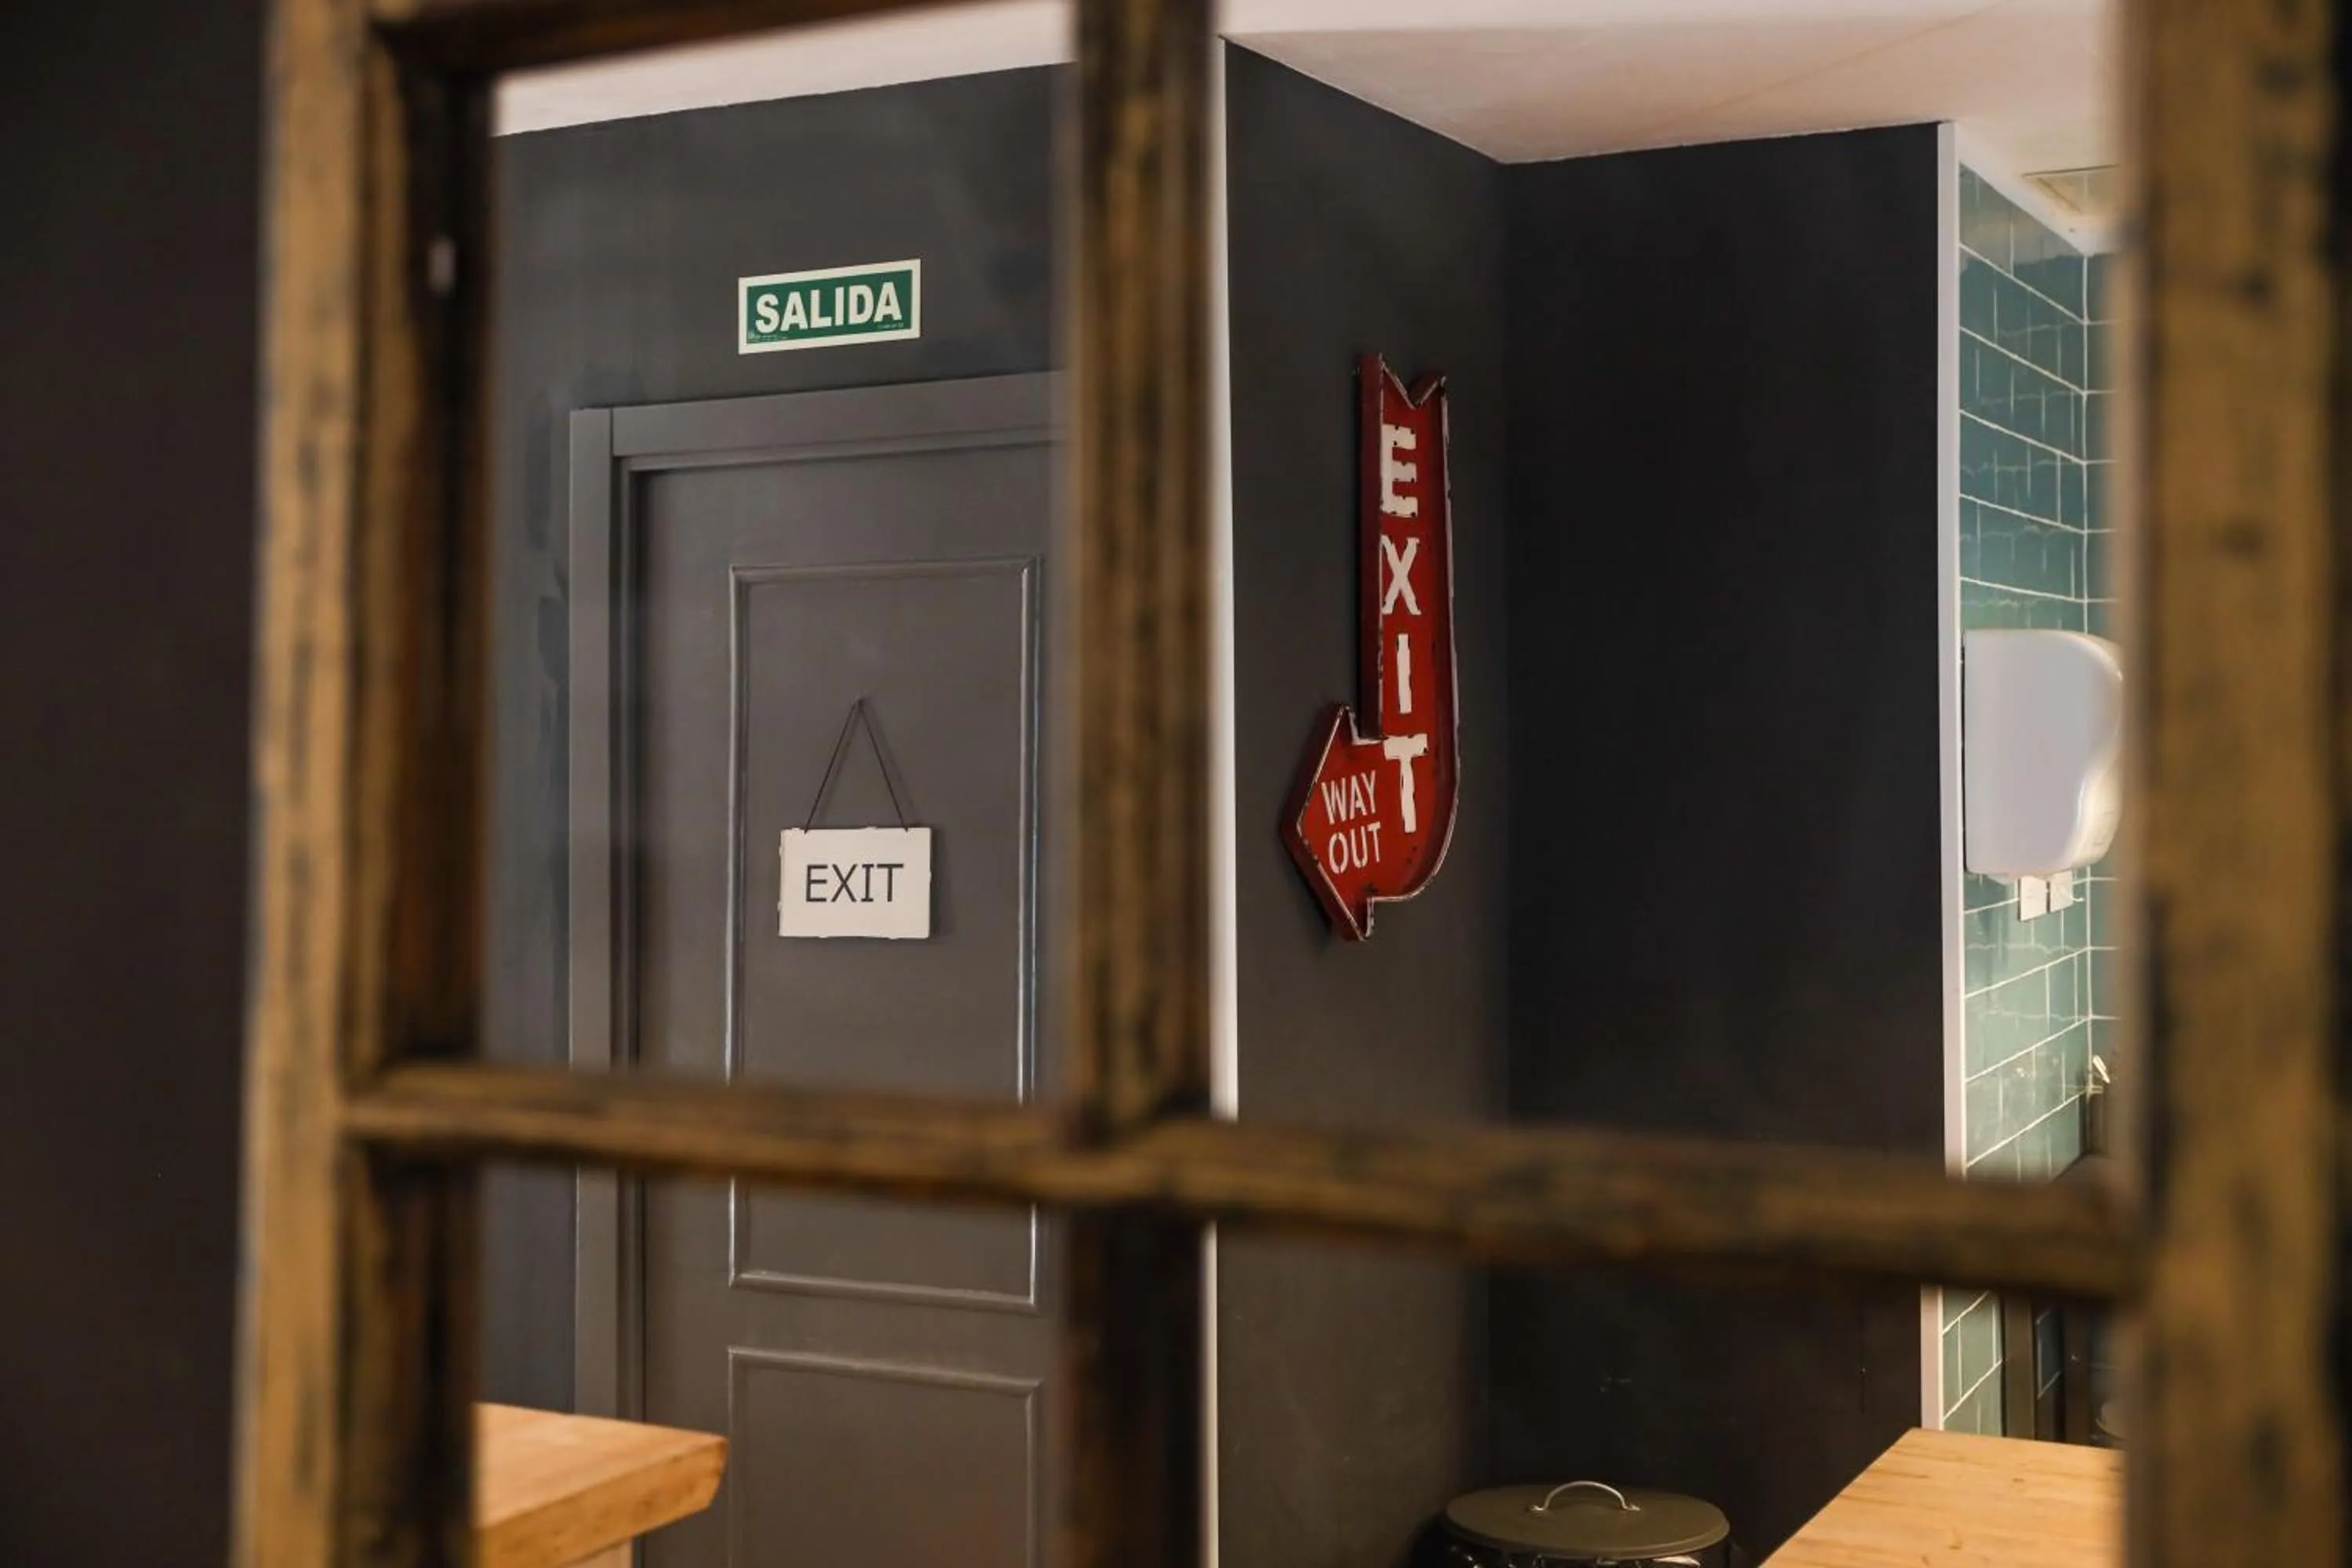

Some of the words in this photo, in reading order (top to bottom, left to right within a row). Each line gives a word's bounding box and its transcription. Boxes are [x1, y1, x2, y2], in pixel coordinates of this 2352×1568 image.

[755, 281, 902, 333] SALIDA
[1380, 424, 1428, 833] EXIT
[1321, 770, 1376, 825] WAY
[1328, 822, 1381, 874] OUT
[806, 864, 904, 902] EXIT
